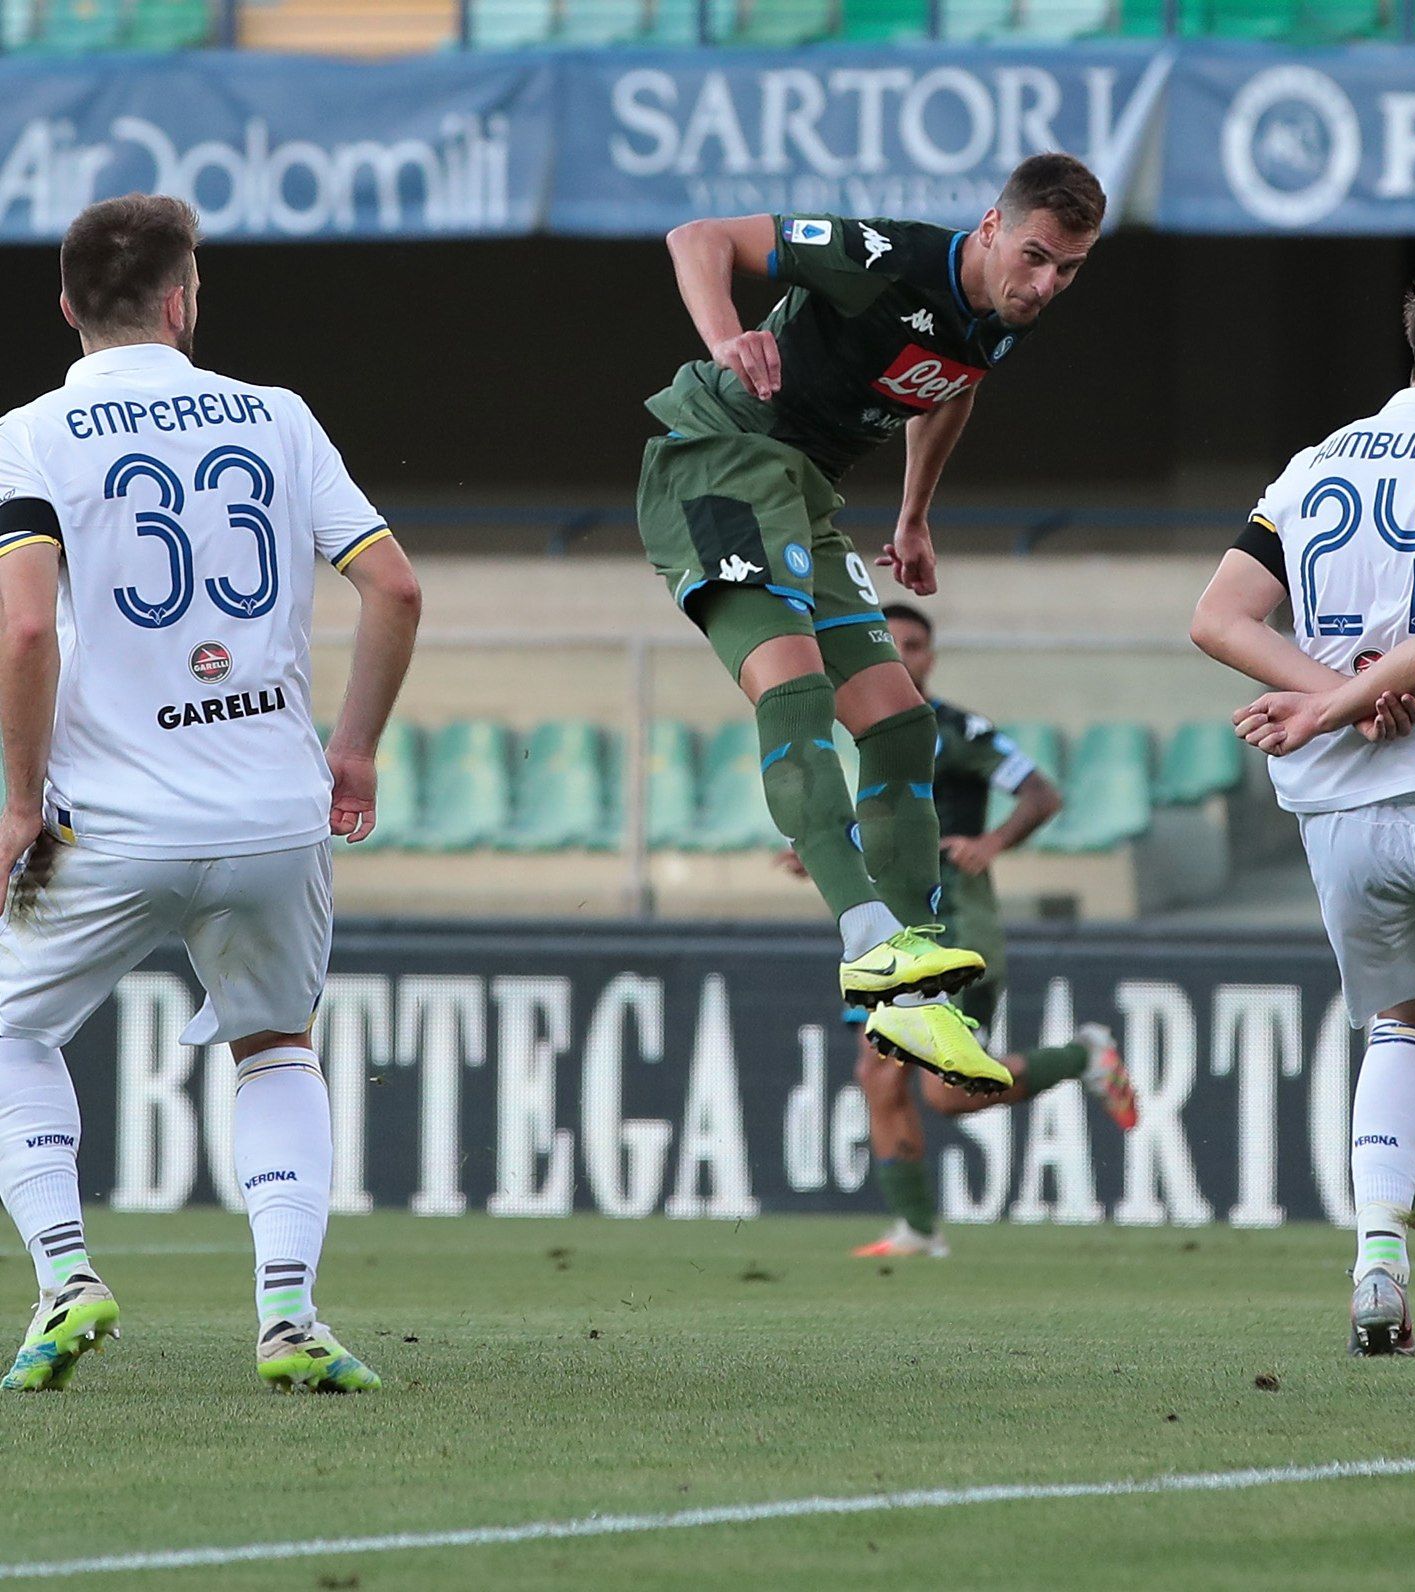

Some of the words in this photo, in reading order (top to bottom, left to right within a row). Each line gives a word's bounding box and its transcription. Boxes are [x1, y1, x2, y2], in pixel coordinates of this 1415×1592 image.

[877, 359, 972, 402] Let
[66, 392, 272, 440] EMPEREUR
[104, 444, 279, 629] 33
[845, 552, 879, 606] 9
[157, 686, 286, 730] GARELLI
[26, 1133, 75, 1148] VERONA
[1354, 1134, 1399, 1148] VERONA
[244, 1170, 298, 1190] VERONA
